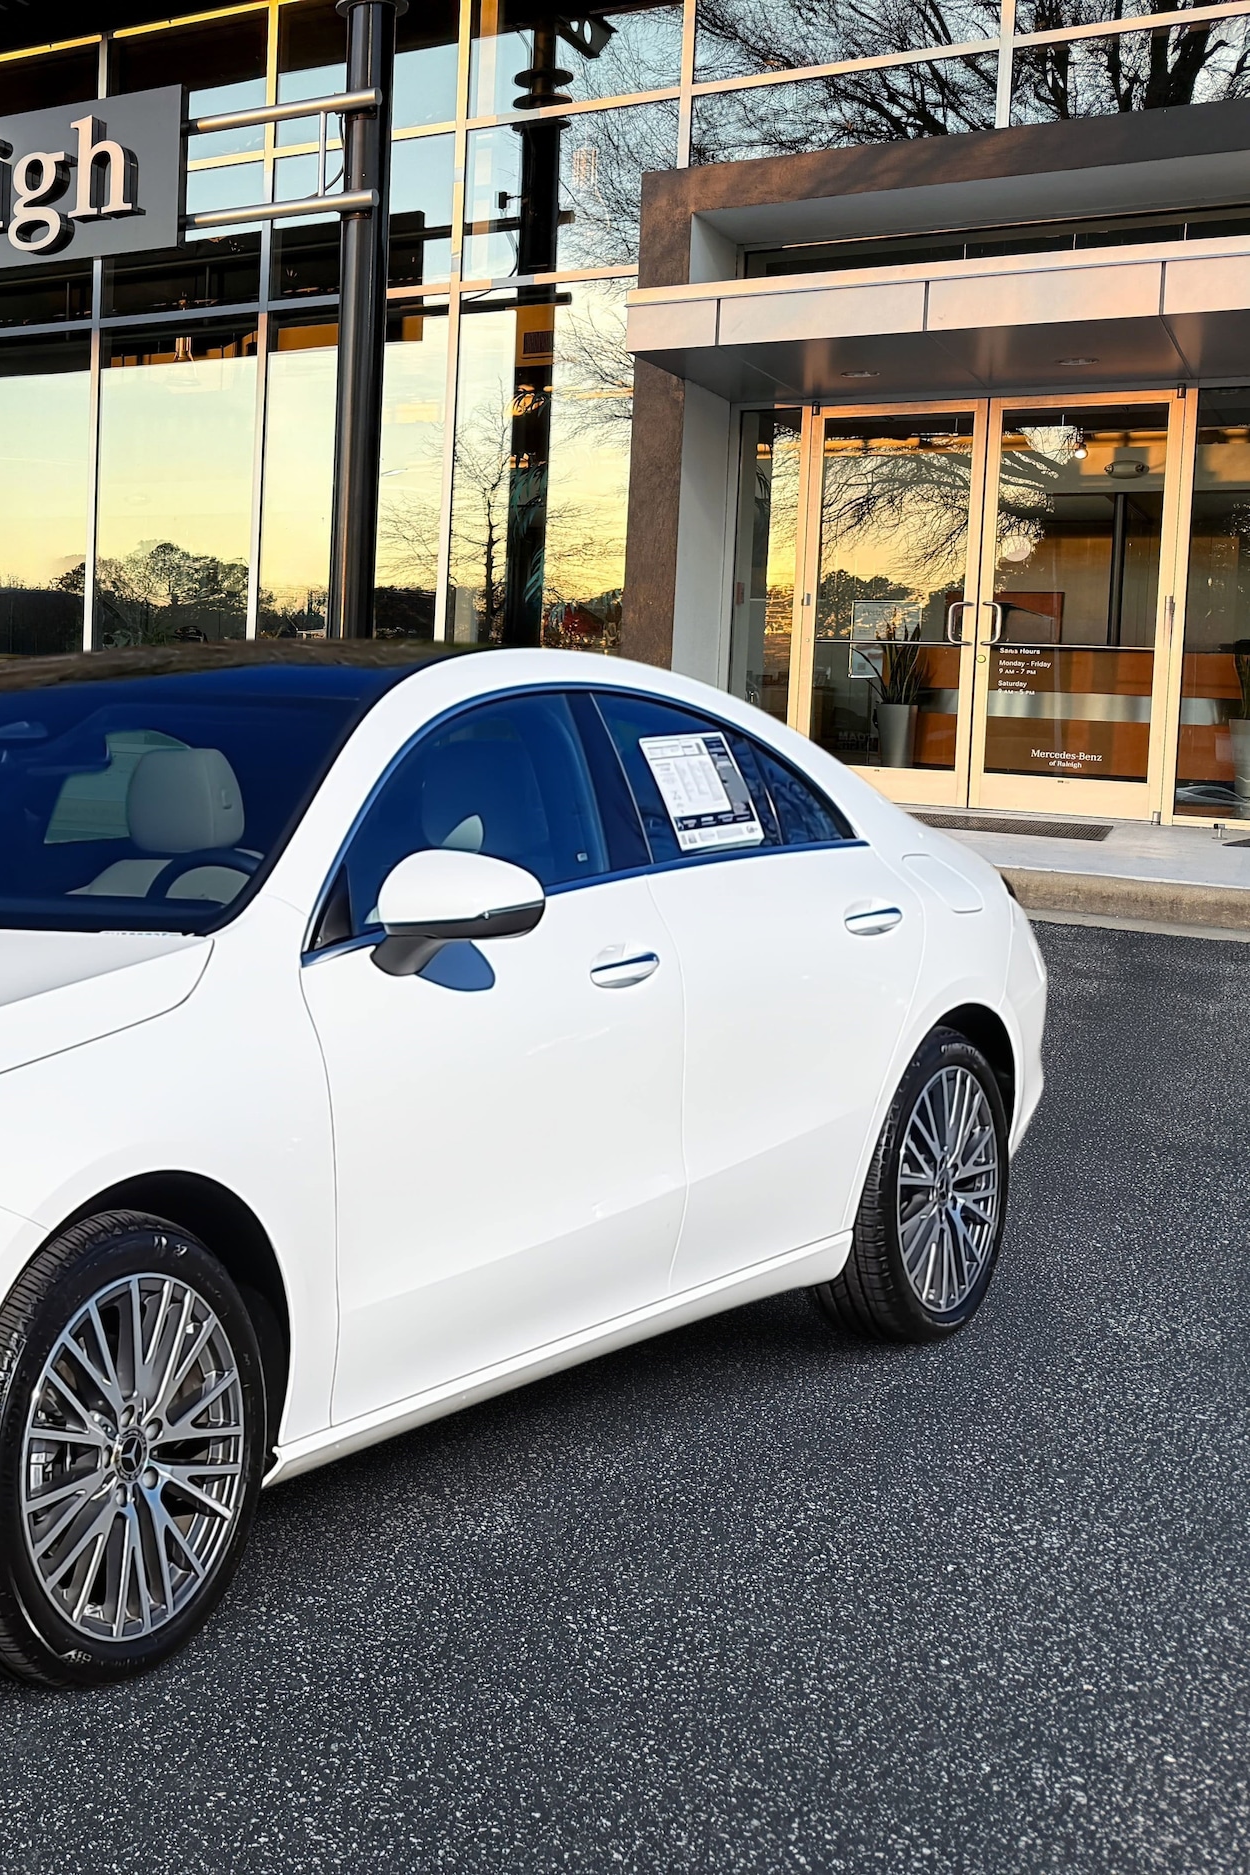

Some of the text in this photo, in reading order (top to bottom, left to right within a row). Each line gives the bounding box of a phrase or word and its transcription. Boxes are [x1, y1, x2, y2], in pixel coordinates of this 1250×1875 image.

[998, 680, 1027, 688] Saturday
[1031, 749, 1102, 761] Mercedes-Benz
[1057, 761, 1082, 769] Raleigh
